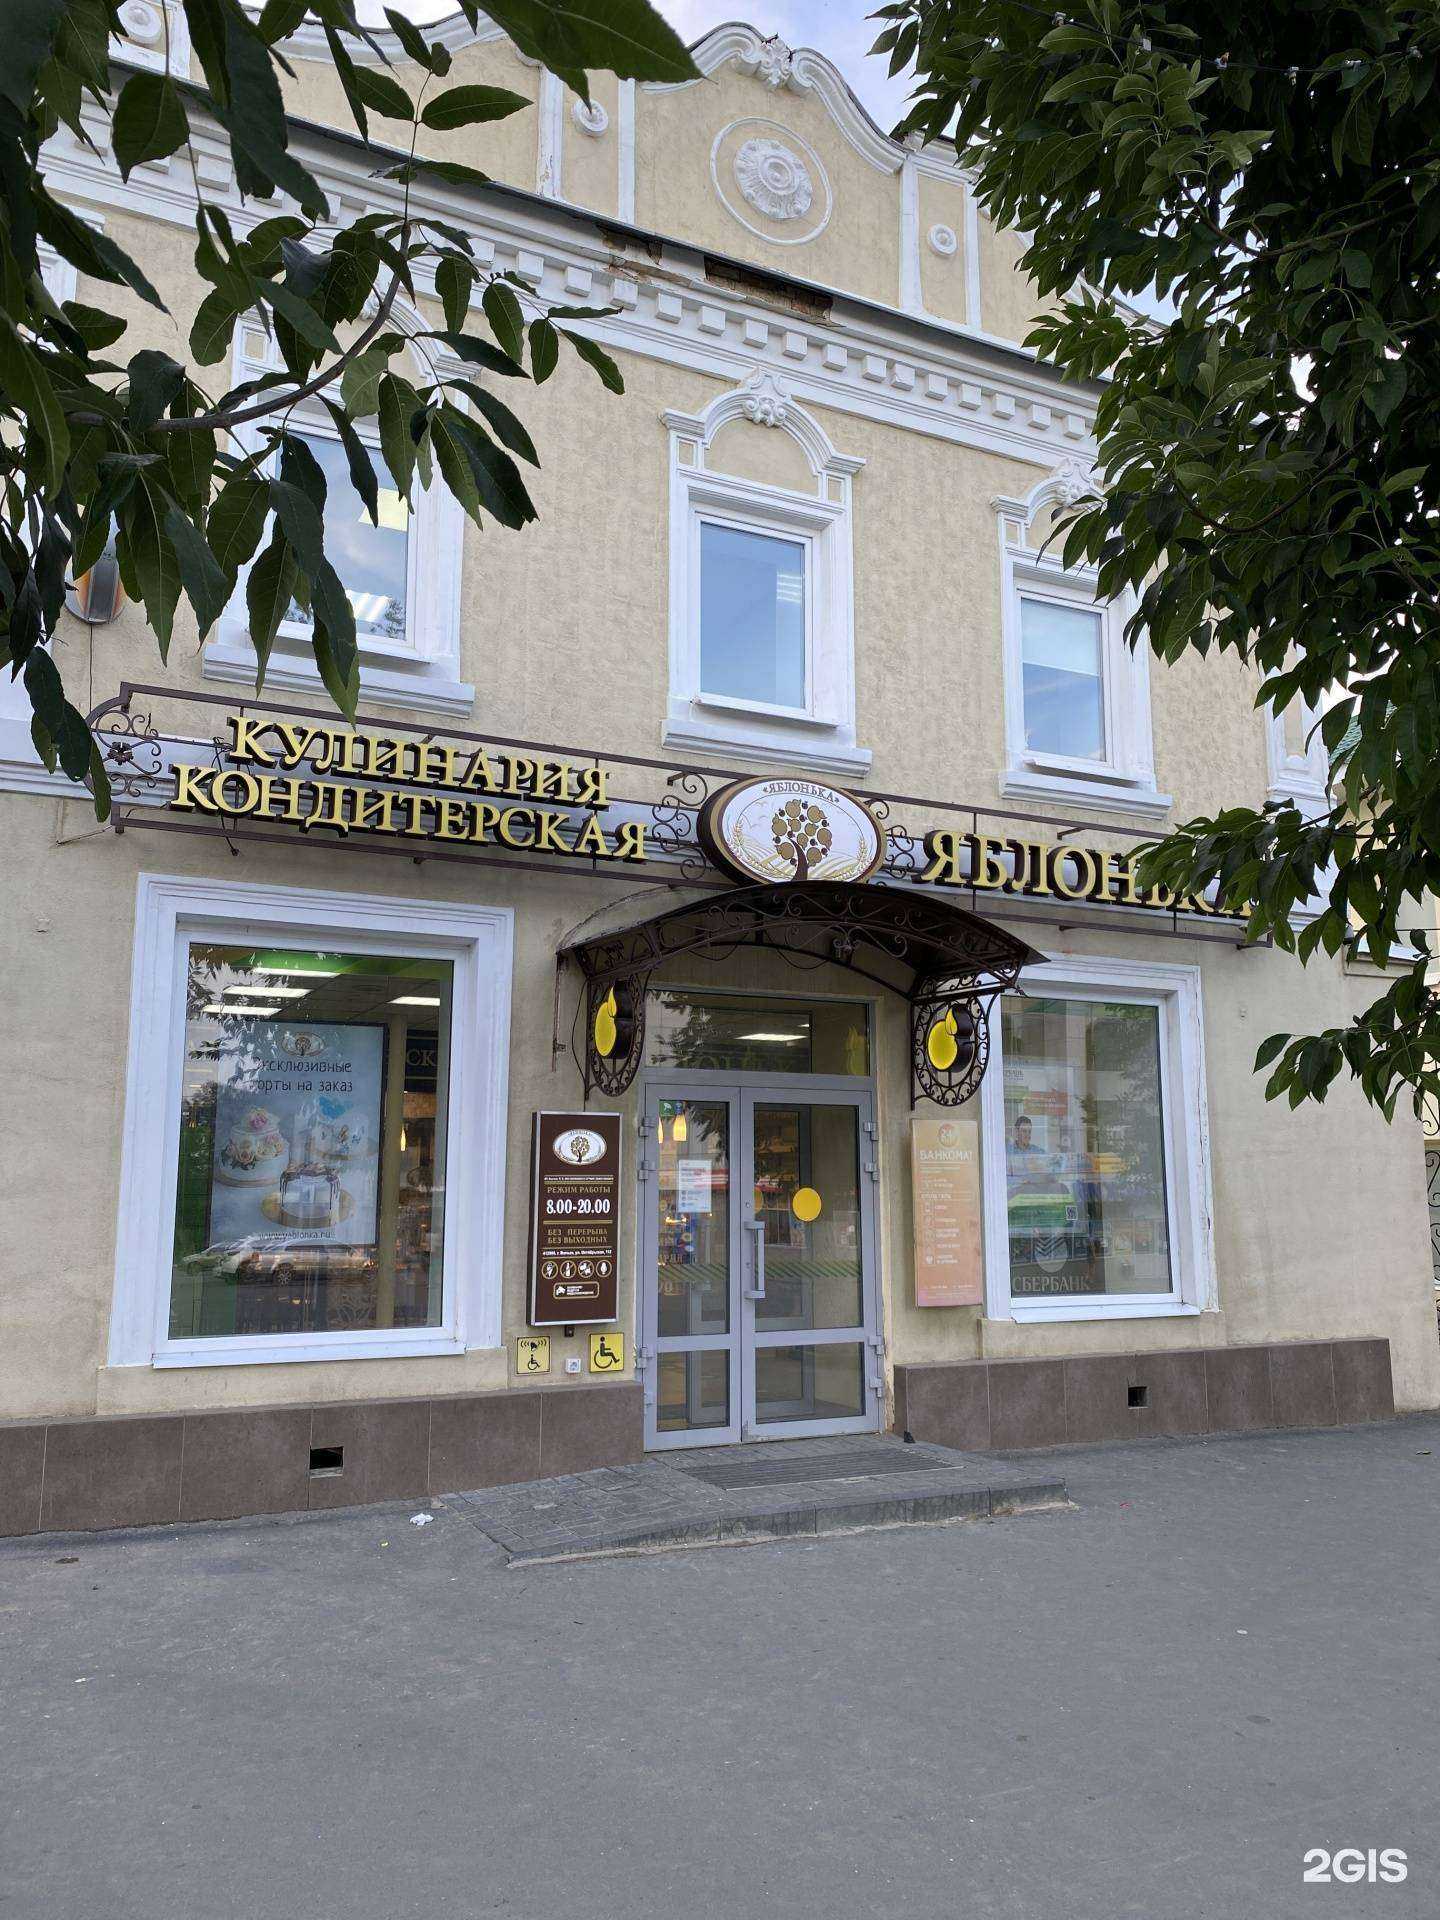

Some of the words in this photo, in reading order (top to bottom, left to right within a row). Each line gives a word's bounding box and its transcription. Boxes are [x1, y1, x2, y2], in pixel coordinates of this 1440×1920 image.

[230, 717, 610, 807] КУЛИНАРИЯ
[171, 763, 649, 862] КОНДИТЕРСКАЯ
[920, 829, 1252, 917] ЯБЛОН
[252, 1080, 291, 1094] орты
[298, 1081, 312, 1090] на
[319, 1081, 352, 1092] заказ
[546, 1199, 610, 1214] 8.00-20.00
[1013, 1276, 1089, 1292] СБЕРБАНК
